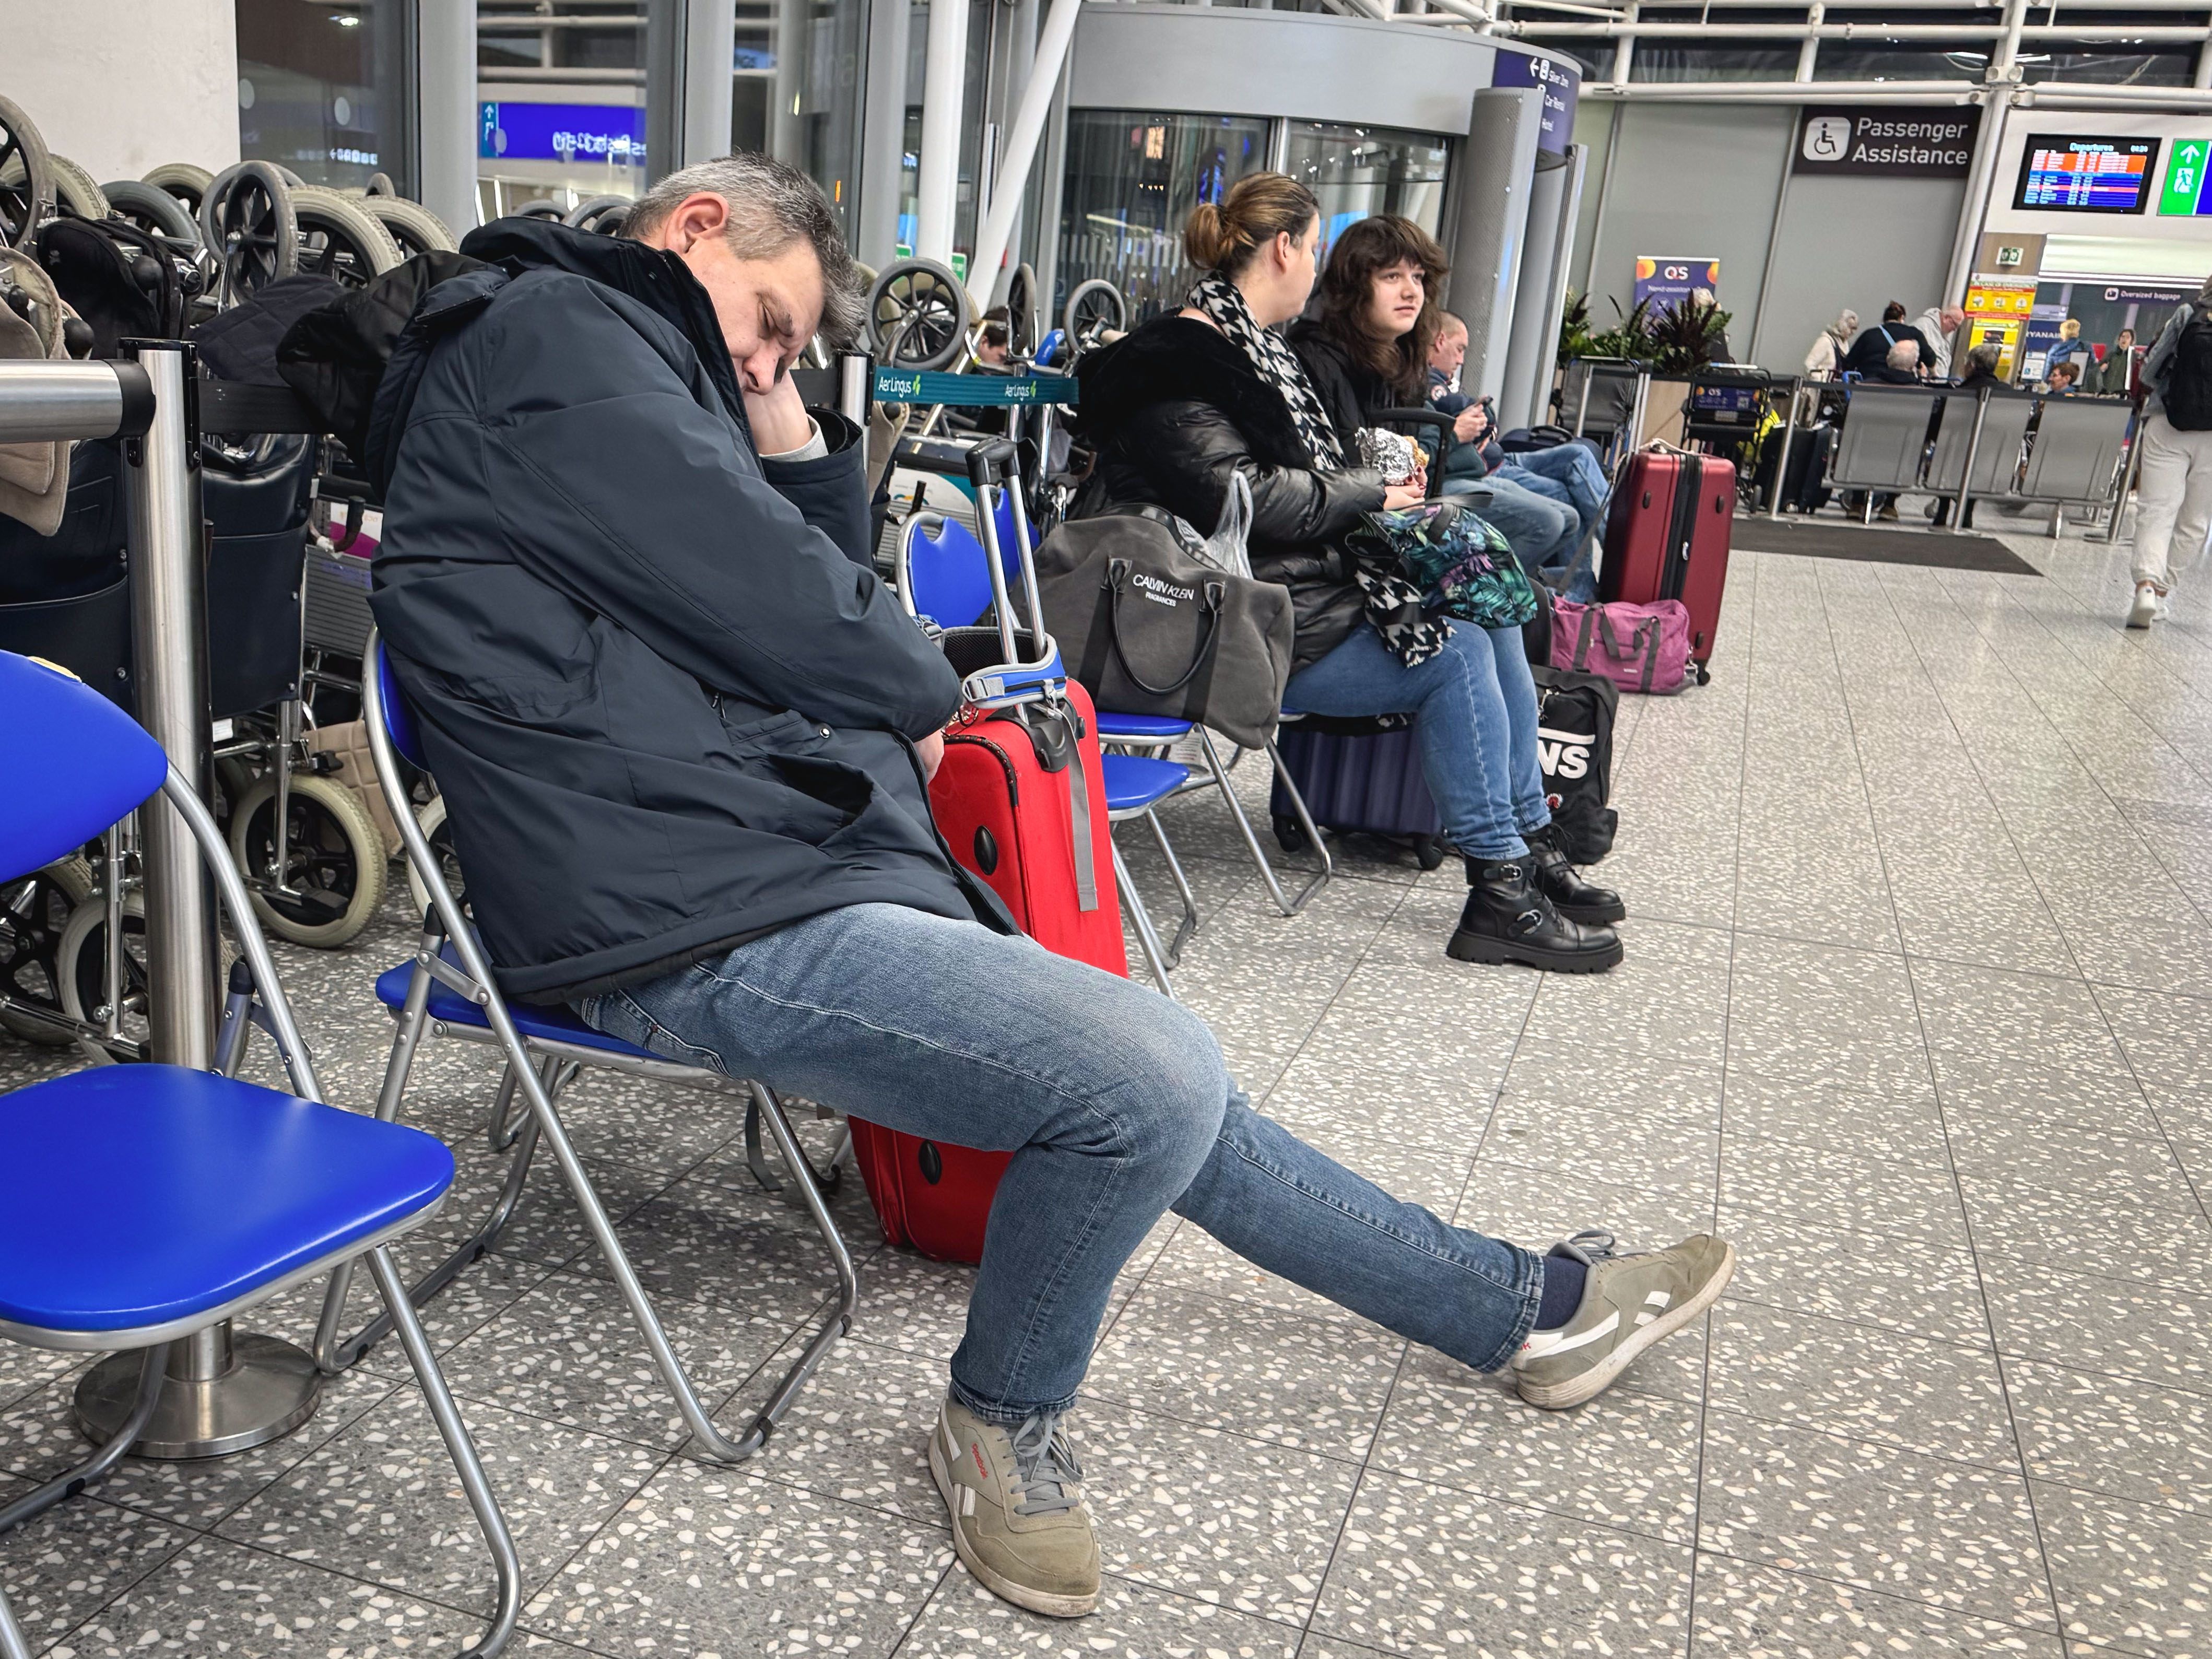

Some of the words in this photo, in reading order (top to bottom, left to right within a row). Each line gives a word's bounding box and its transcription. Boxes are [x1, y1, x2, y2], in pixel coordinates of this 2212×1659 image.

[1856, 117, 1969, 143] Passenger
[1852, 143, 1968, 164] Assistance
[2120, 290, 2152, 298] Oversized
[2154, 292, 2181, 301] baggage
[878, 376, 890, 391] Aer
[890, 377, 912, 398] Lingus
[1005, 384, 1014, 397] Aer
[1014, 385, 1029, 401] Lingus
[1133, 574, 1169, 594] CALVIN
[1167, 585, 1194, 600] KLEIN
[1145, 591, 1176, 607] FRAGRANCES
[1538, 739, 1590, 779] NS
